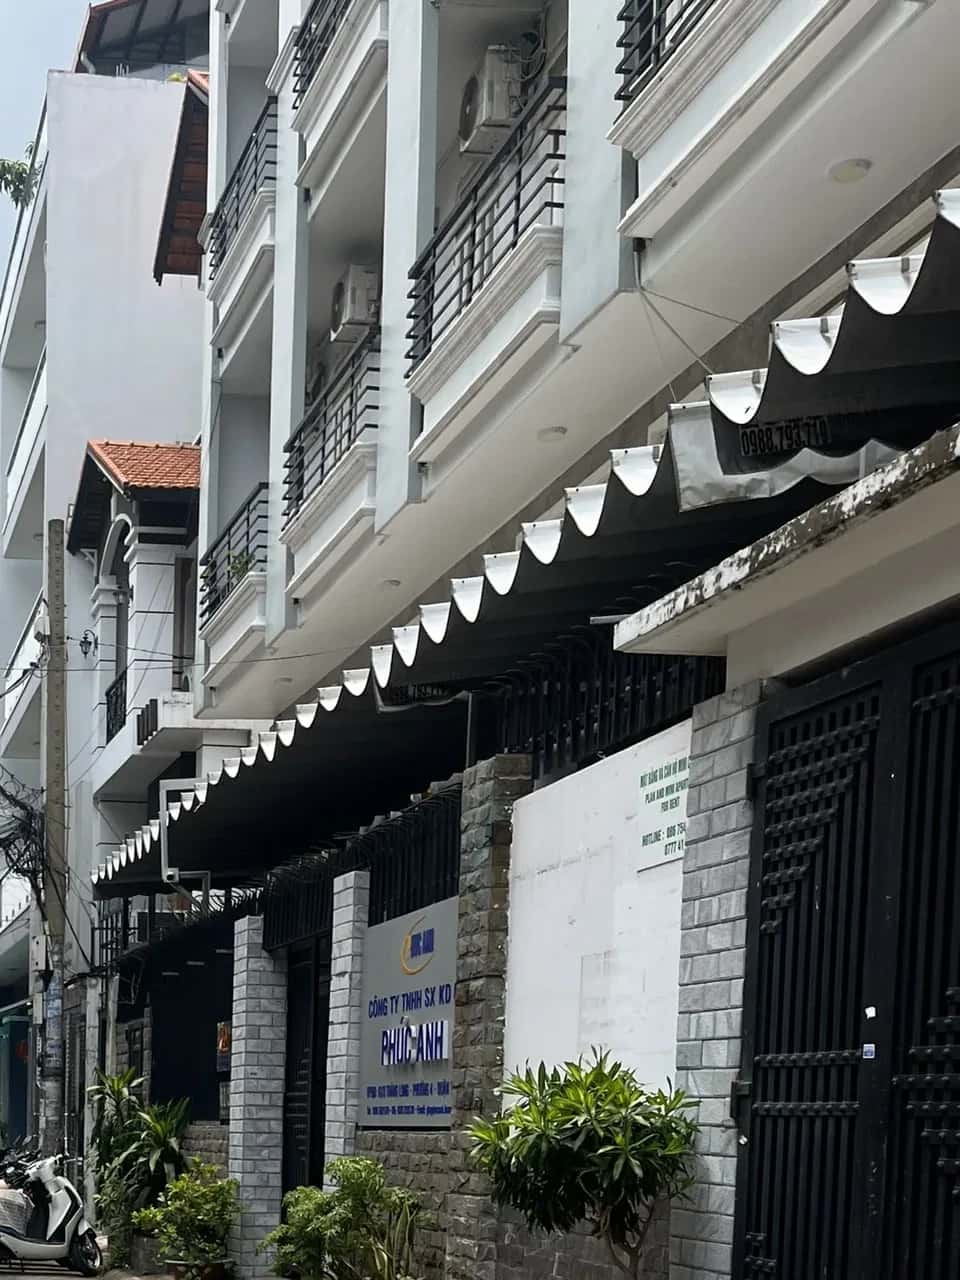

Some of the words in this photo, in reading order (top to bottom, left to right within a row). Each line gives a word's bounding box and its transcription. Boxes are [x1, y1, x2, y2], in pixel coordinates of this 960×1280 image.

[656, 787, 664, 800] AND
[670, 796, 680, 810] RENT
[368, 995, 388, 1018] CÔNG
[390, 995, 400, 1014] TY
[402, 990, 422, 1013] TNHH
[425, 986, 436, 1008] SX
[439, 983, 452, 1005] KD
[381, 1016, 414, 1066] PHÚC
[416, 1020, 445, 1062] ANH
